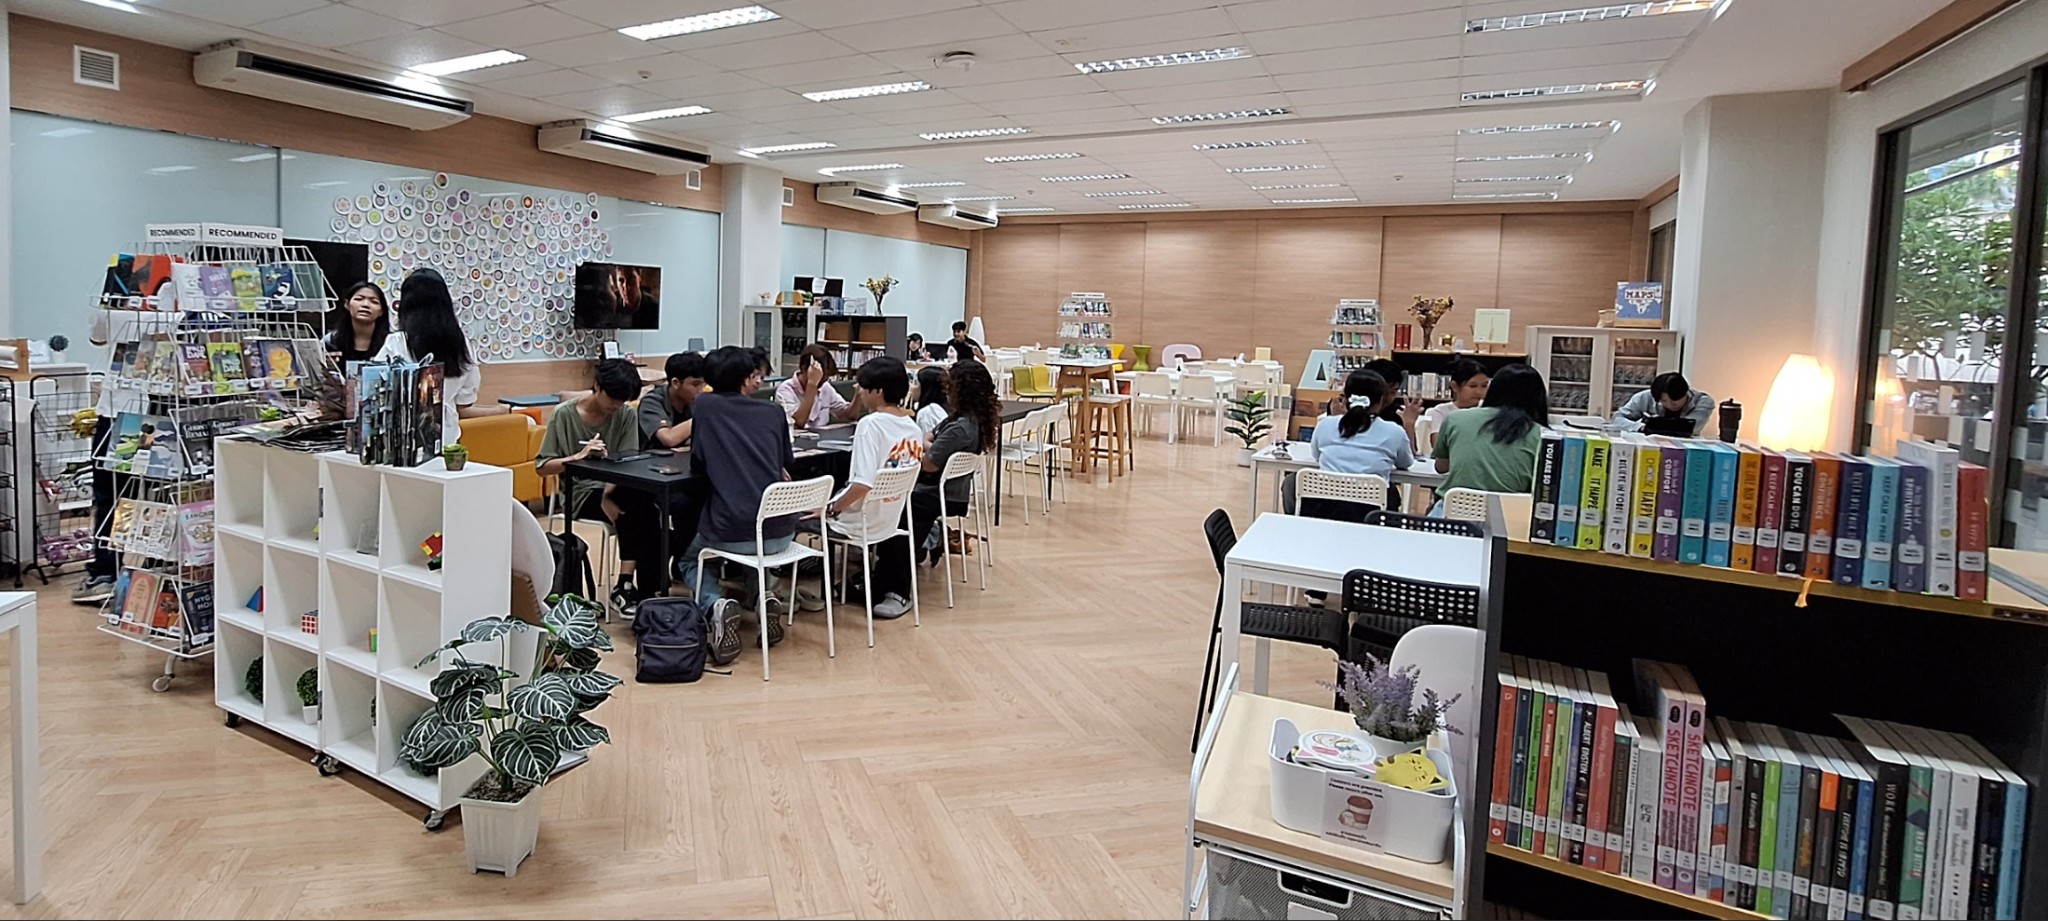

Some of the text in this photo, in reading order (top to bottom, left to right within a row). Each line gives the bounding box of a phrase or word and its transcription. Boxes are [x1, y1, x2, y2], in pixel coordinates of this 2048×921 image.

[150, 229, 195, 237] RECOMMENDED
[208, 228, 278, 240] RECOMMENDED
[1625, 290, 1654, 299] MAPS
[1546, 443, 1555, 459] YOU
[1543, 459, 1553, 474] ARE
[1793, 466, 1805, 484] YOU
[1542, 474, 1551, 485] SO
[1587, 447, 1604, 510] MAKE IT HAPPE
[1662, 458, 1673, 495] COMFORT
[1767, 472, 1778, 491] KEEP
[1882, 475, 1892, 493] KEEP
[1766, 491, 1777, 509] CALM
[1792, 485, 1803, 504] CAN
[1815, 472, 1828, 520] CONFIDENCE
[1903, 477, 1915, 531] SPIRITUALITY
[1638, 491, 1655, 519] HAPPY
[1791, 505, 1801, 519] DO
[1880, 495, 1890, 514] CALM
[1579, 720, 1592, 775] ALBERT EINSTEIN
[1663, 729, 1681, 806] SKETCHNOTE
[1682, 733, 1700, 811] SKETCHNOTE
[1884, 783, 1897, 813] WORK
